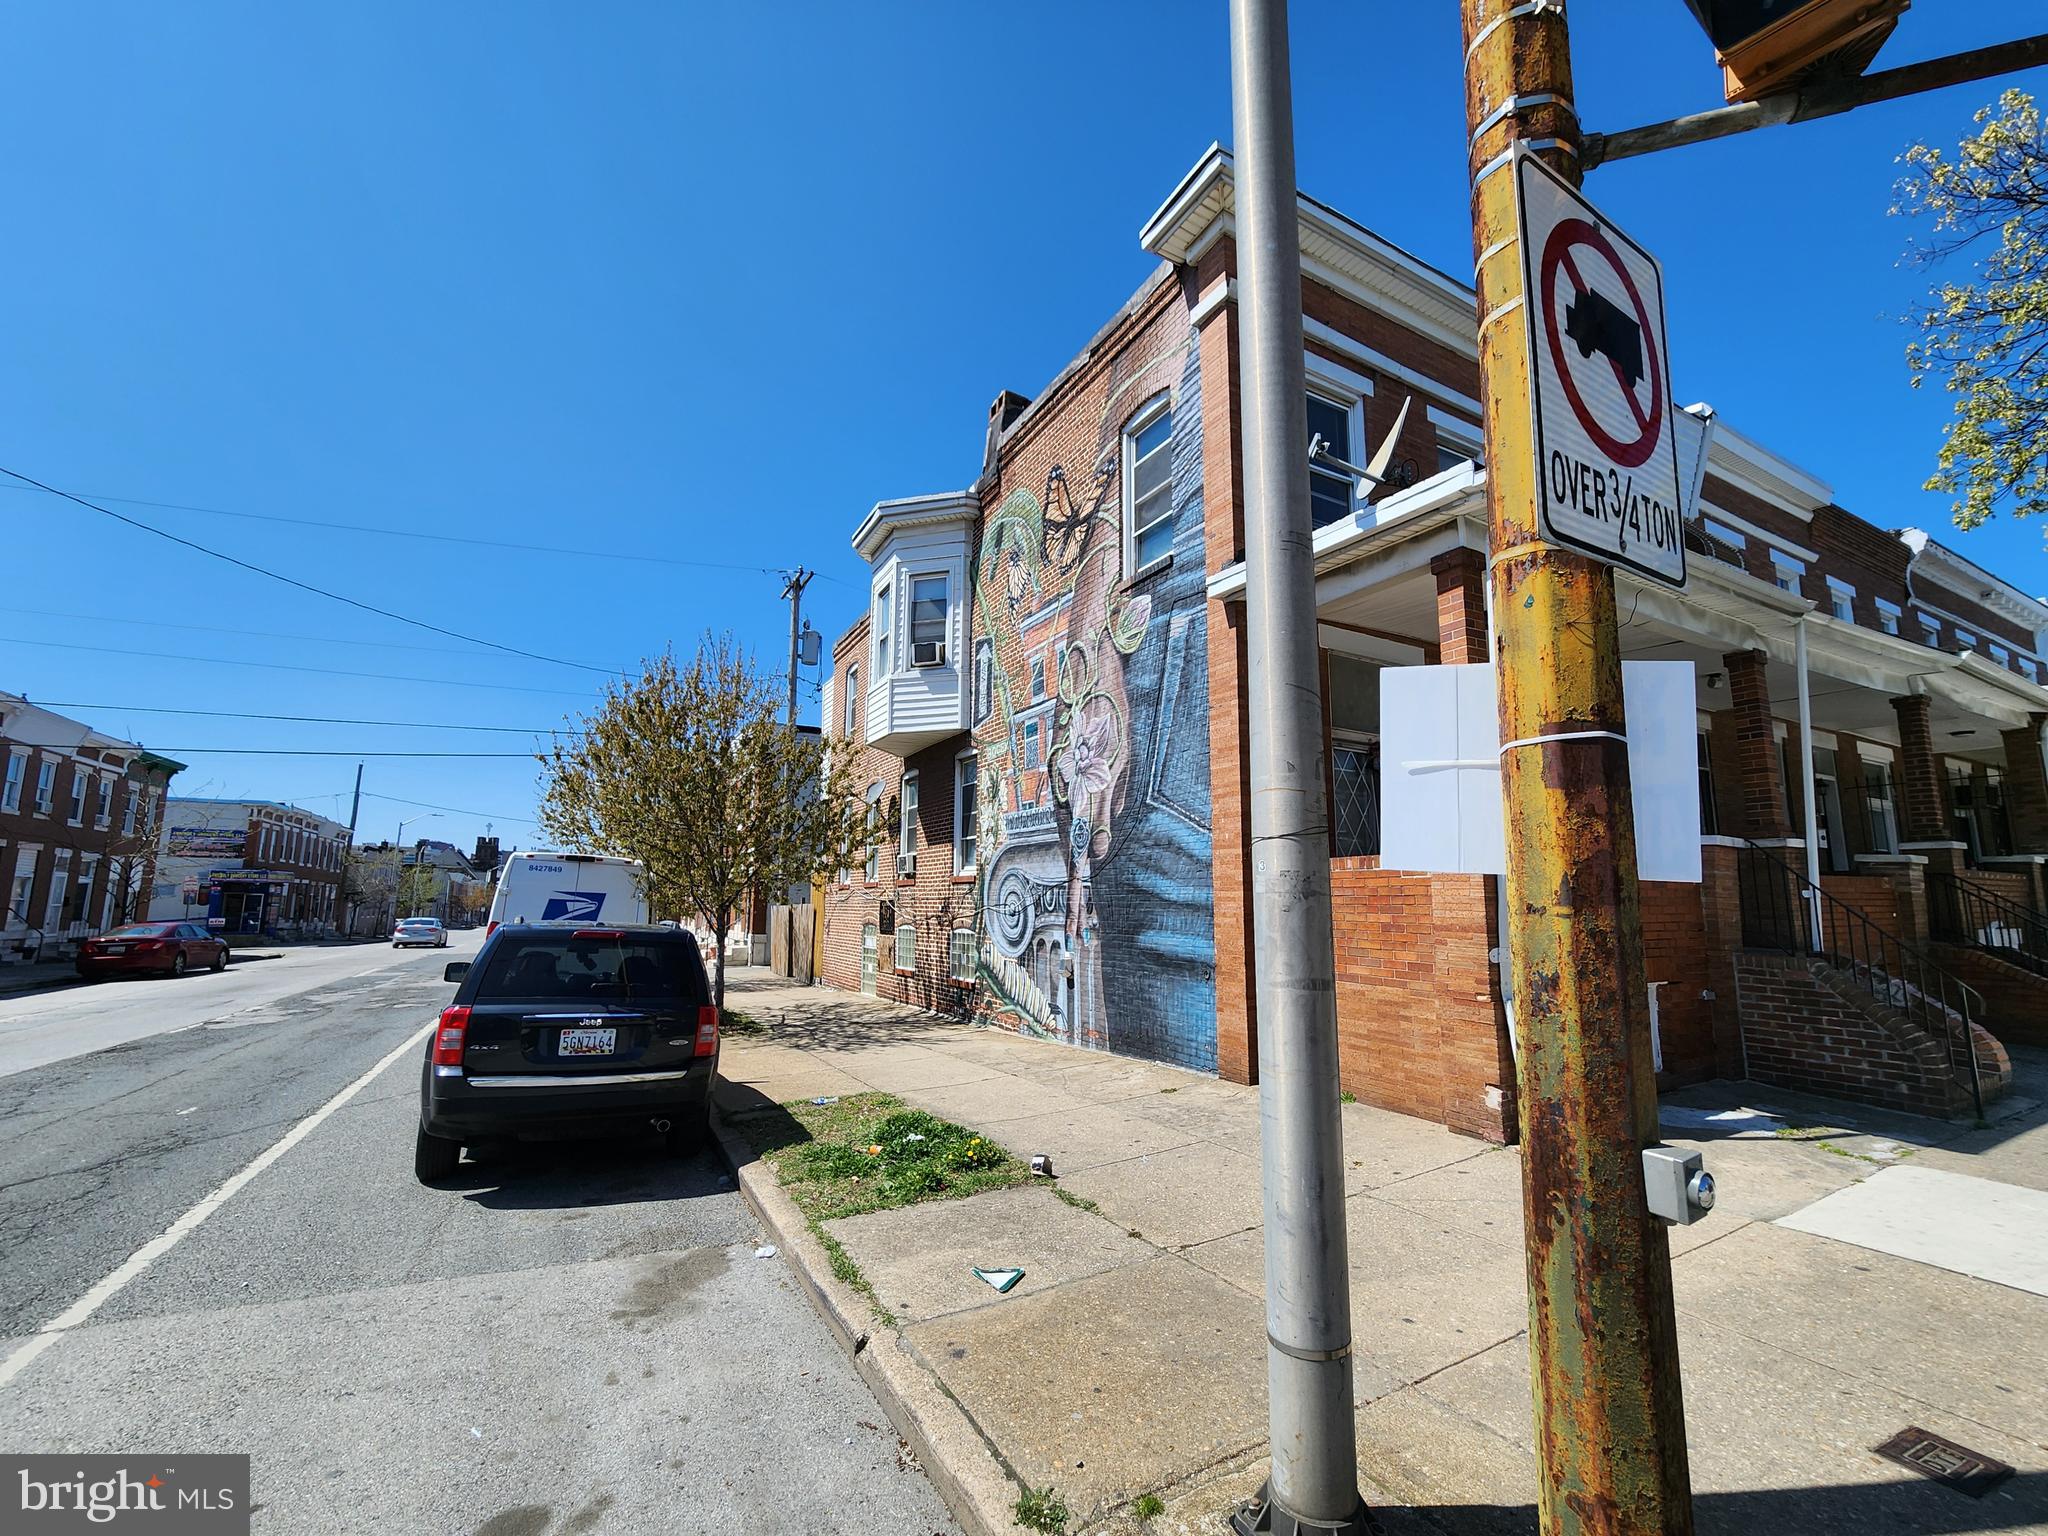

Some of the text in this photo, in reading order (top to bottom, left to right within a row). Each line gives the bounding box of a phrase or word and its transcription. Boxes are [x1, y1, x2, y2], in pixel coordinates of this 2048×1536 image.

[1551, 449, 1677, 555] OVER 3/4 TON
[528, 864, 563, 873] 8427849
[579, 1018, 602, 1027] Jeep
[562, 1035, 613, 1050] 5GN7164
